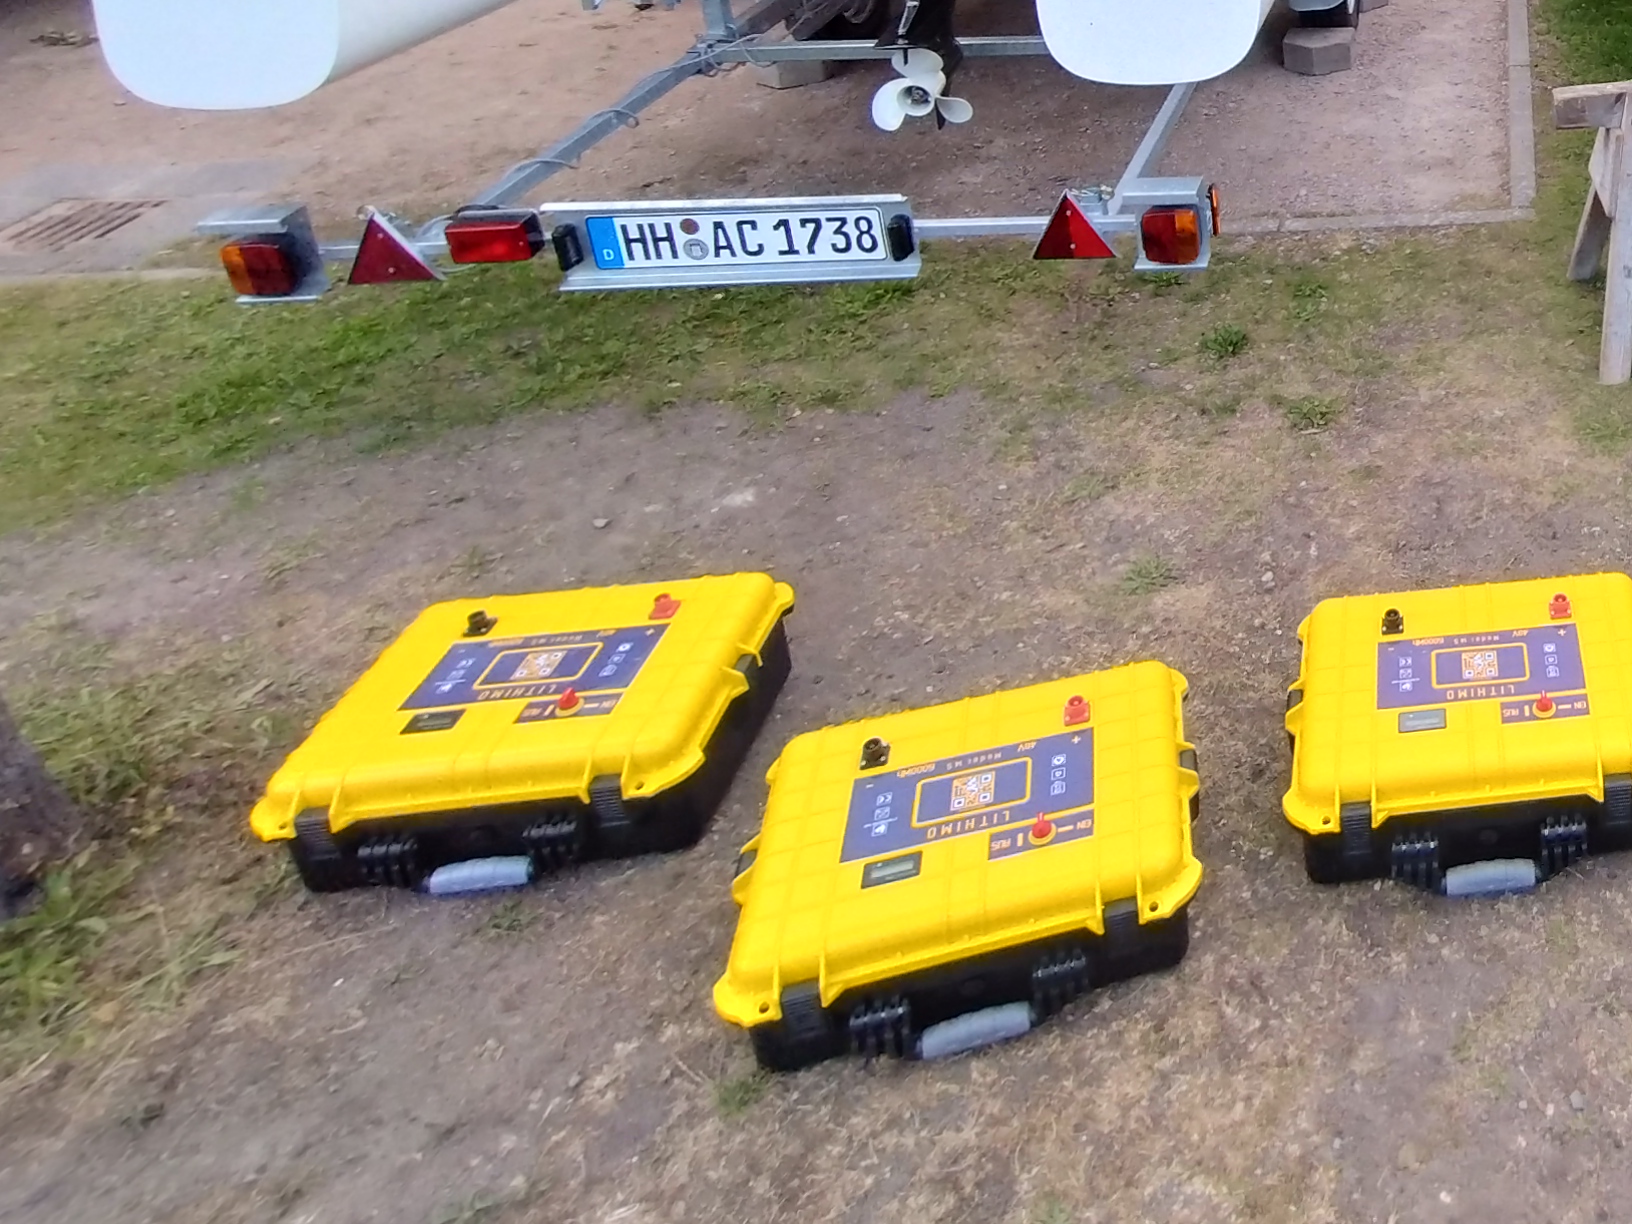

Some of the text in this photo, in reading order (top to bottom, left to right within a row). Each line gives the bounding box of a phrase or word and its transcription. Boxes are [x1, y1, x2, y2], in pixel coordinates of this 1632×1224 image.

[620, 216, 879, 262] HH AC 1738
[602, 249, 614, 261] D
[477, 684, 556, 700] LITHIMO
[1446, 684, 1515, 700] LITHIMO
[926, 809, 1011, 841] LITHIMO
[990, 837, 1012, 851] AUS
